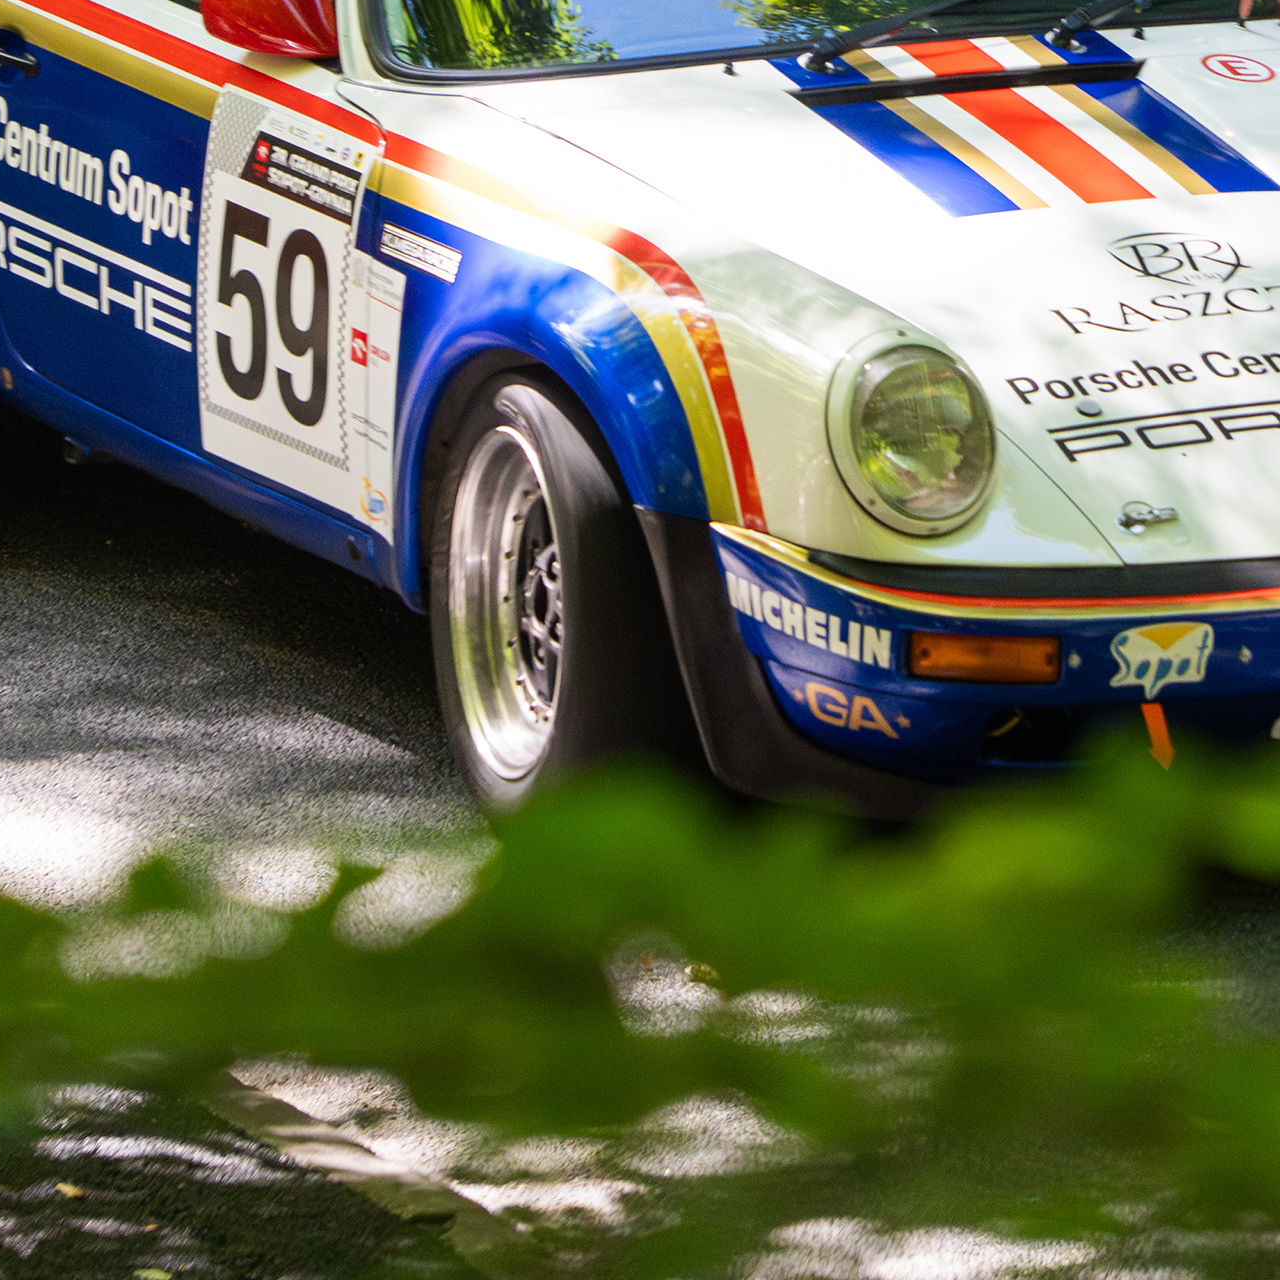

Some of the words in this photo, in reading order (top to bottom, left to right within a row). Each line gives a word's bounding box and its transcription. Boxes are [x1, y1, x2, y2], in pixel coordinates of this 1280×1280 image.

[1217, 59, 1262, 77] E
[106, 148, 194, 246] Sopot
[215, 199, 330, 426] 59
[1006, 359, 1198, 405] Porsche
[725, 570, 893, 670] MICHELIN
[1111, 629, 1210, 696] Sopot
[805, 681, 901, 740] GA
